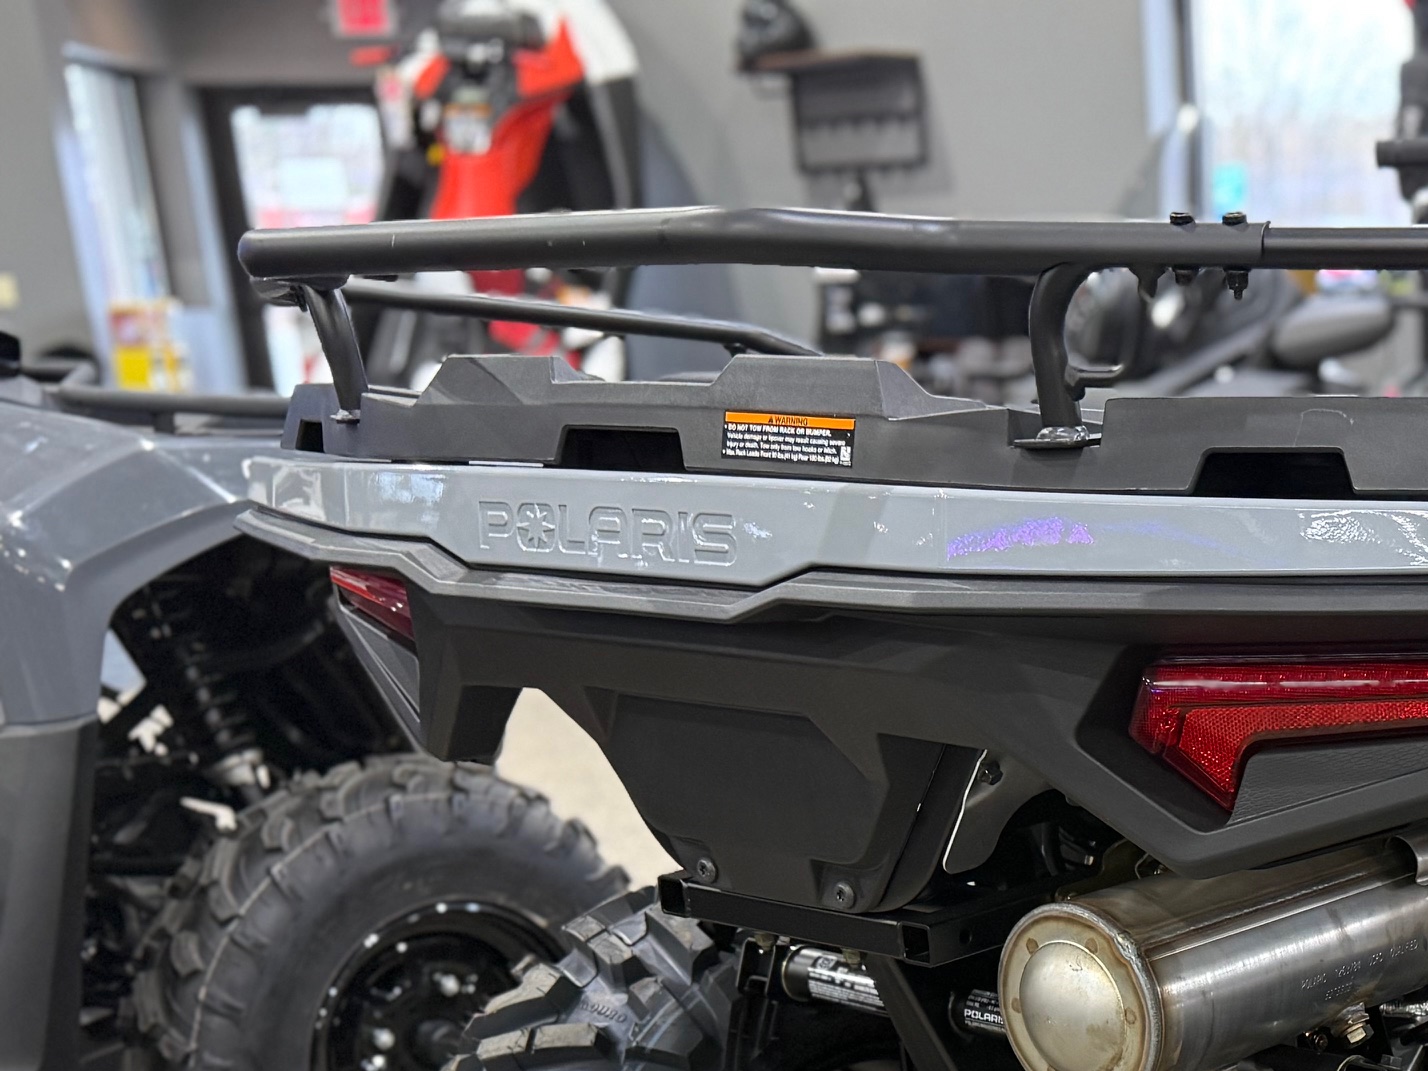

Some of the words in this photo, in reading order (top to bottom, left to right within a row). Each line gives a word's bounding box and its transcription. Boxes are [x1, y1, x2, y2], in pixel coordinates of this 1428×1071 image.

[775, 416, 808, 427] WARNING
[728, 423, 736, 431] DO
[737, 424, 748, 432] NOT
[749, 424, 762, 432] TOW
[763, 425, 779, 434] FROM
[780, 426, 795, 435] RACK
[796, 427, 804, 435] OR
[478, 500, 738, 567] POLARIS
[964, 1008, 1004, 1025] POLARI
